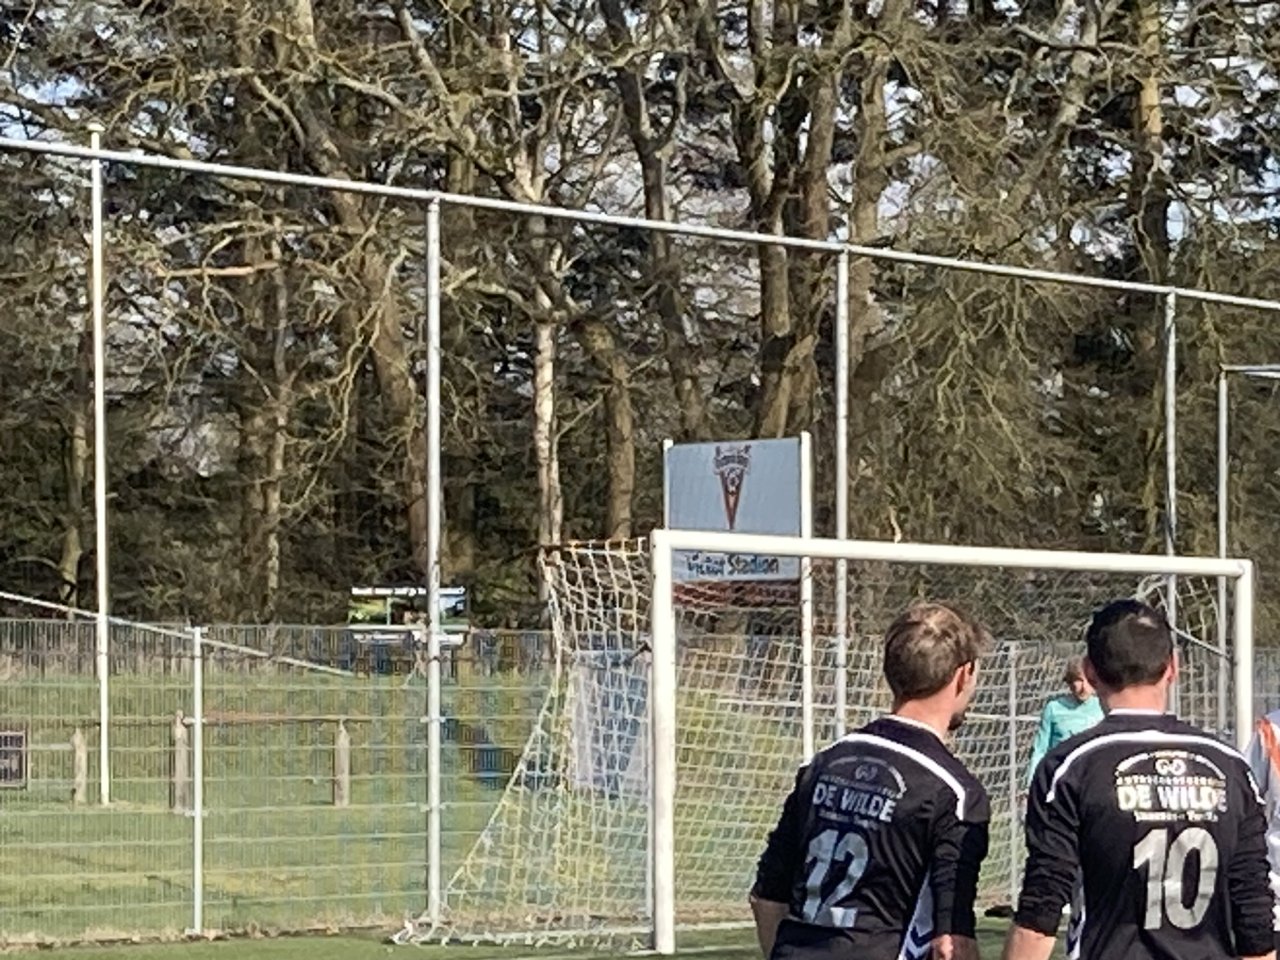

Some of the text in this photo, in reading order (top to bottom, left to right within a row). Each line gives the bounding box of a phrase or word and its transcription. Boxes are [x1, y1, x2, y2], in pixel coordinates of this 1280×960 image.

[812, 782, 838, 807] DE
[840, 788, 897, 823] WILDE
[1116, 785, 1228, 813] DE WILDE
[802, 828, 869, 928] 12
[1133, 827, 1219, 930] 10
